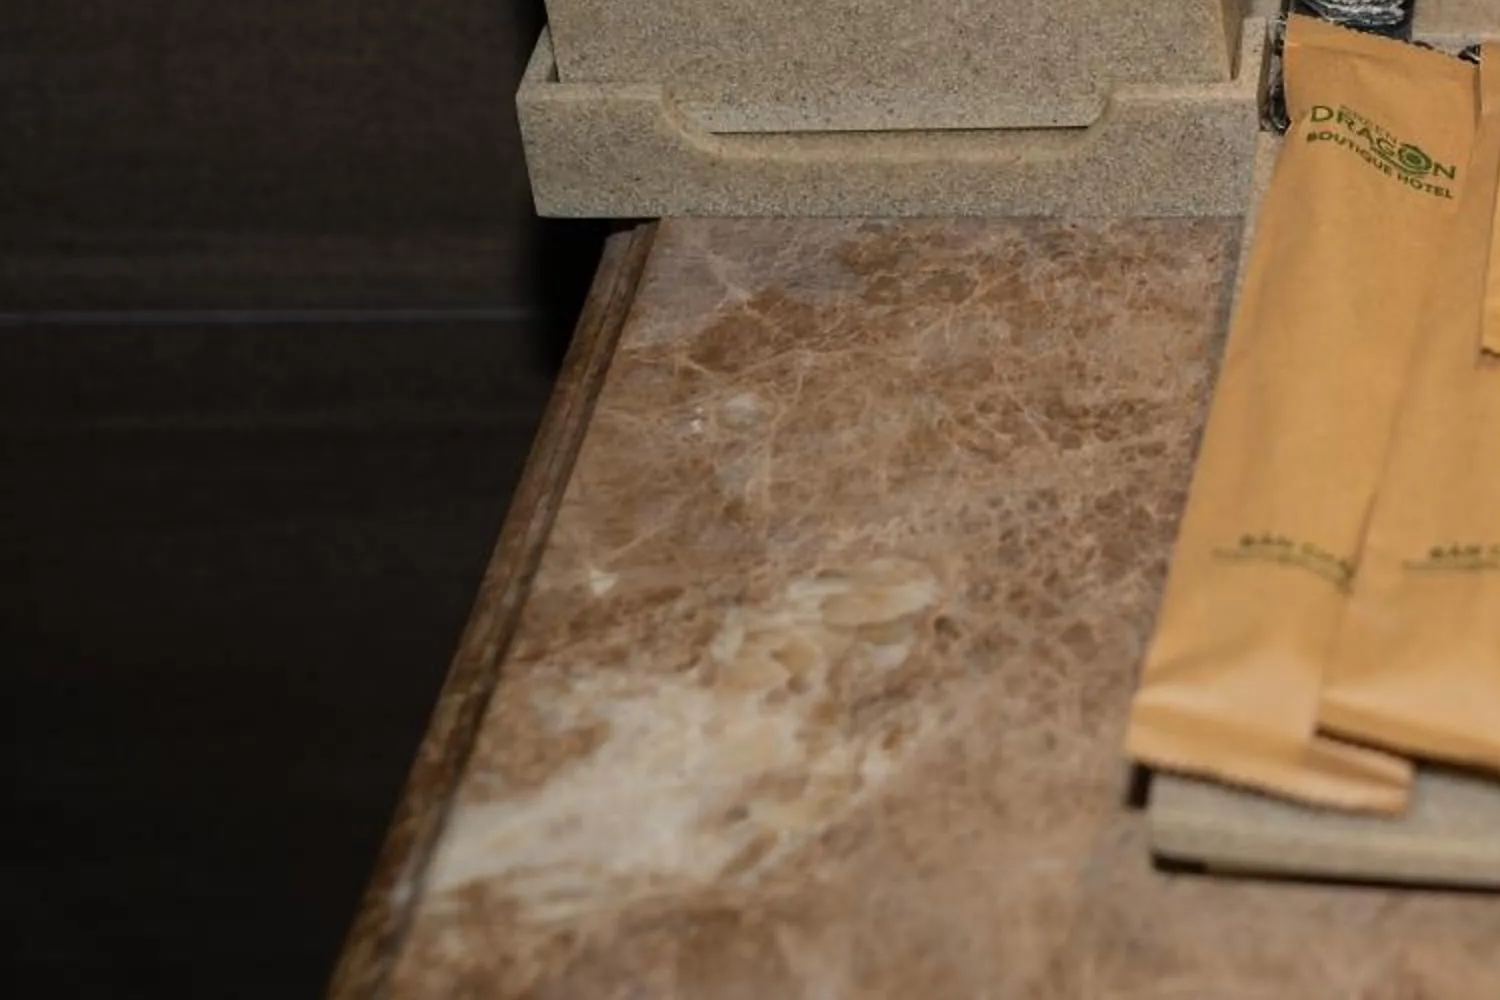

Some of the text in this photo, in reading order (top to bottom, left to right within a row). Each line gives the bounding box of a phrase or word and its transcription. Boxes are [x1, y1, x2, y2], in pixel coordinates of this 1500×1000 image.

[1306, 131, 1454, 200] BOUTIQUE HOTEL
[1310, 105, 1457, 180] DRAGON
